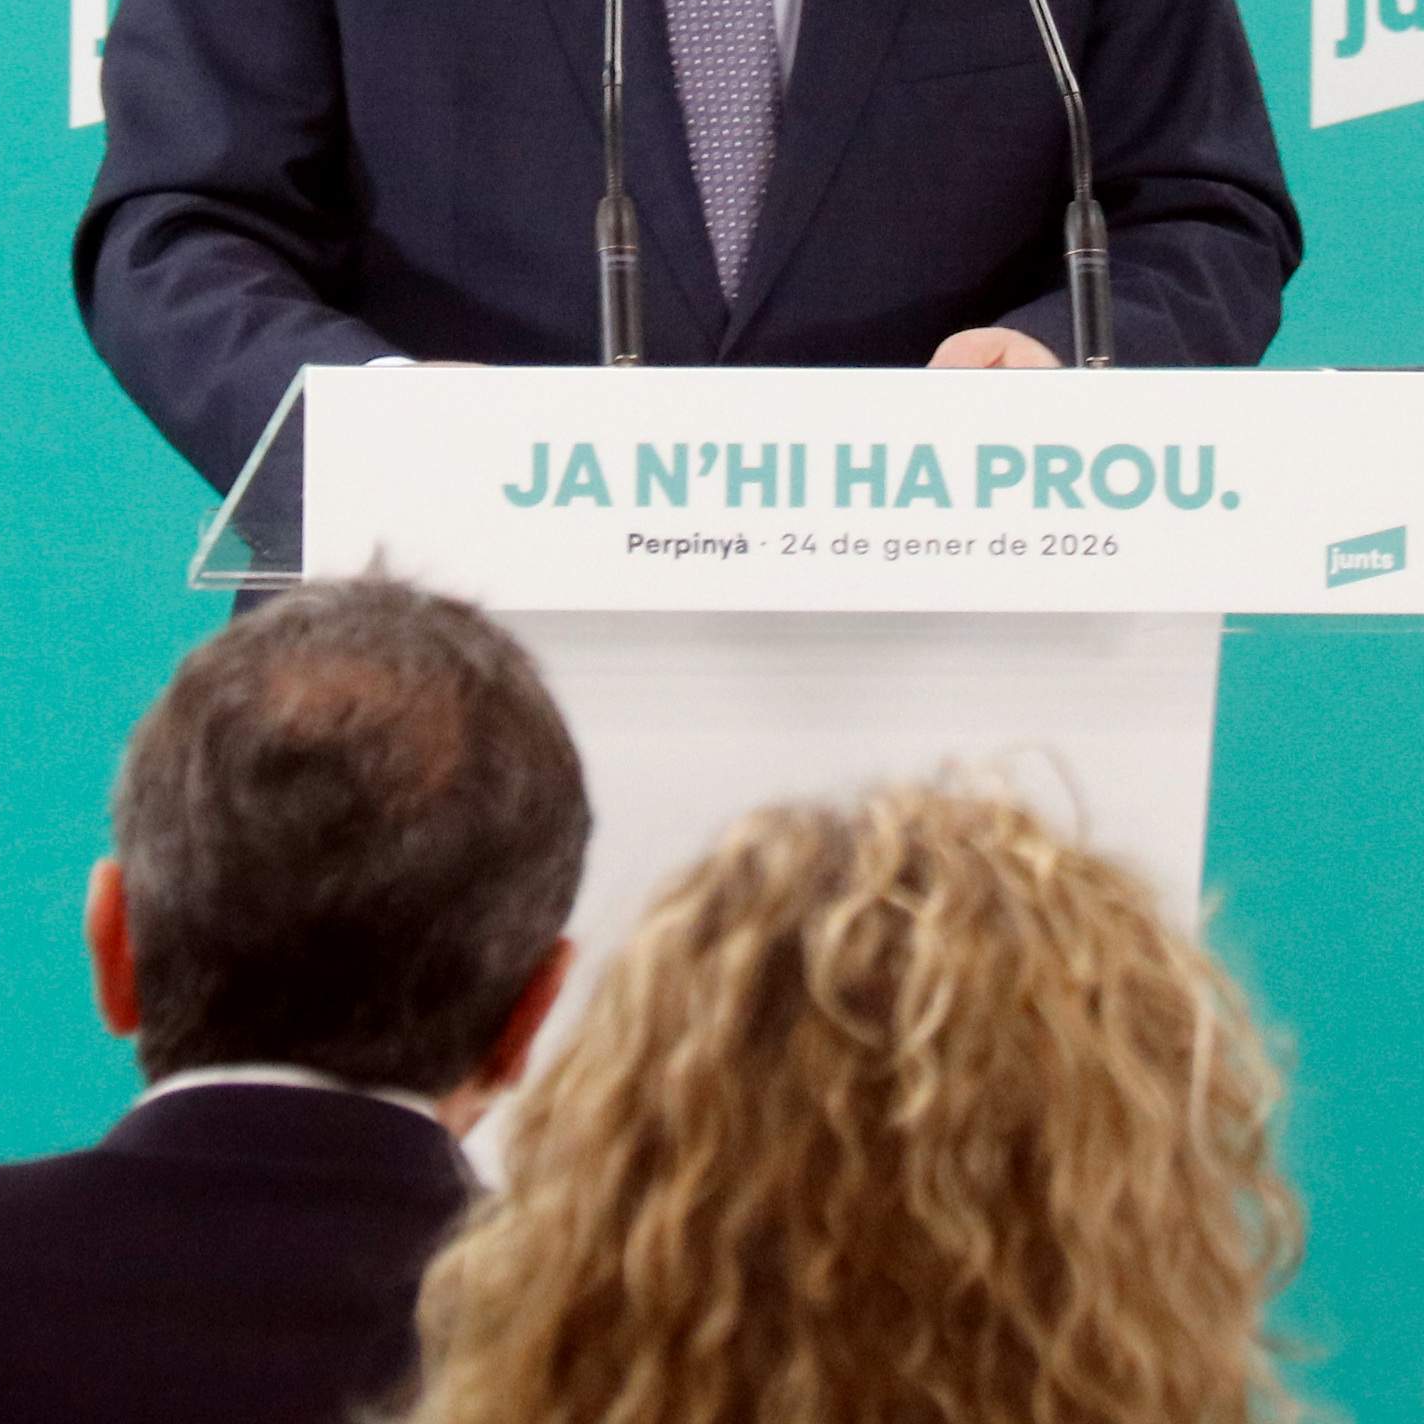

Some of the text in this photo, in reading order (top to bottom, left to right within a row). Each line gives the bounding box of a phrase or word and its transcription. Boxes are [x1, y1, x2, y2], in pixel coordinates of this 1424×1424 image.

[502, 442, 1242, 512] JA N’HI HA PROU.
[627, 532, 750, 561] Perpinyà
[780, 532, 818, 556] 24
[830, 532, 870, 556] de
[883, 537, 976, 562] gener
[988, 532, 1029, 557] de
[1040, 533, 1119, 557] 2026
[1330, 546, 1395, 575] junts
